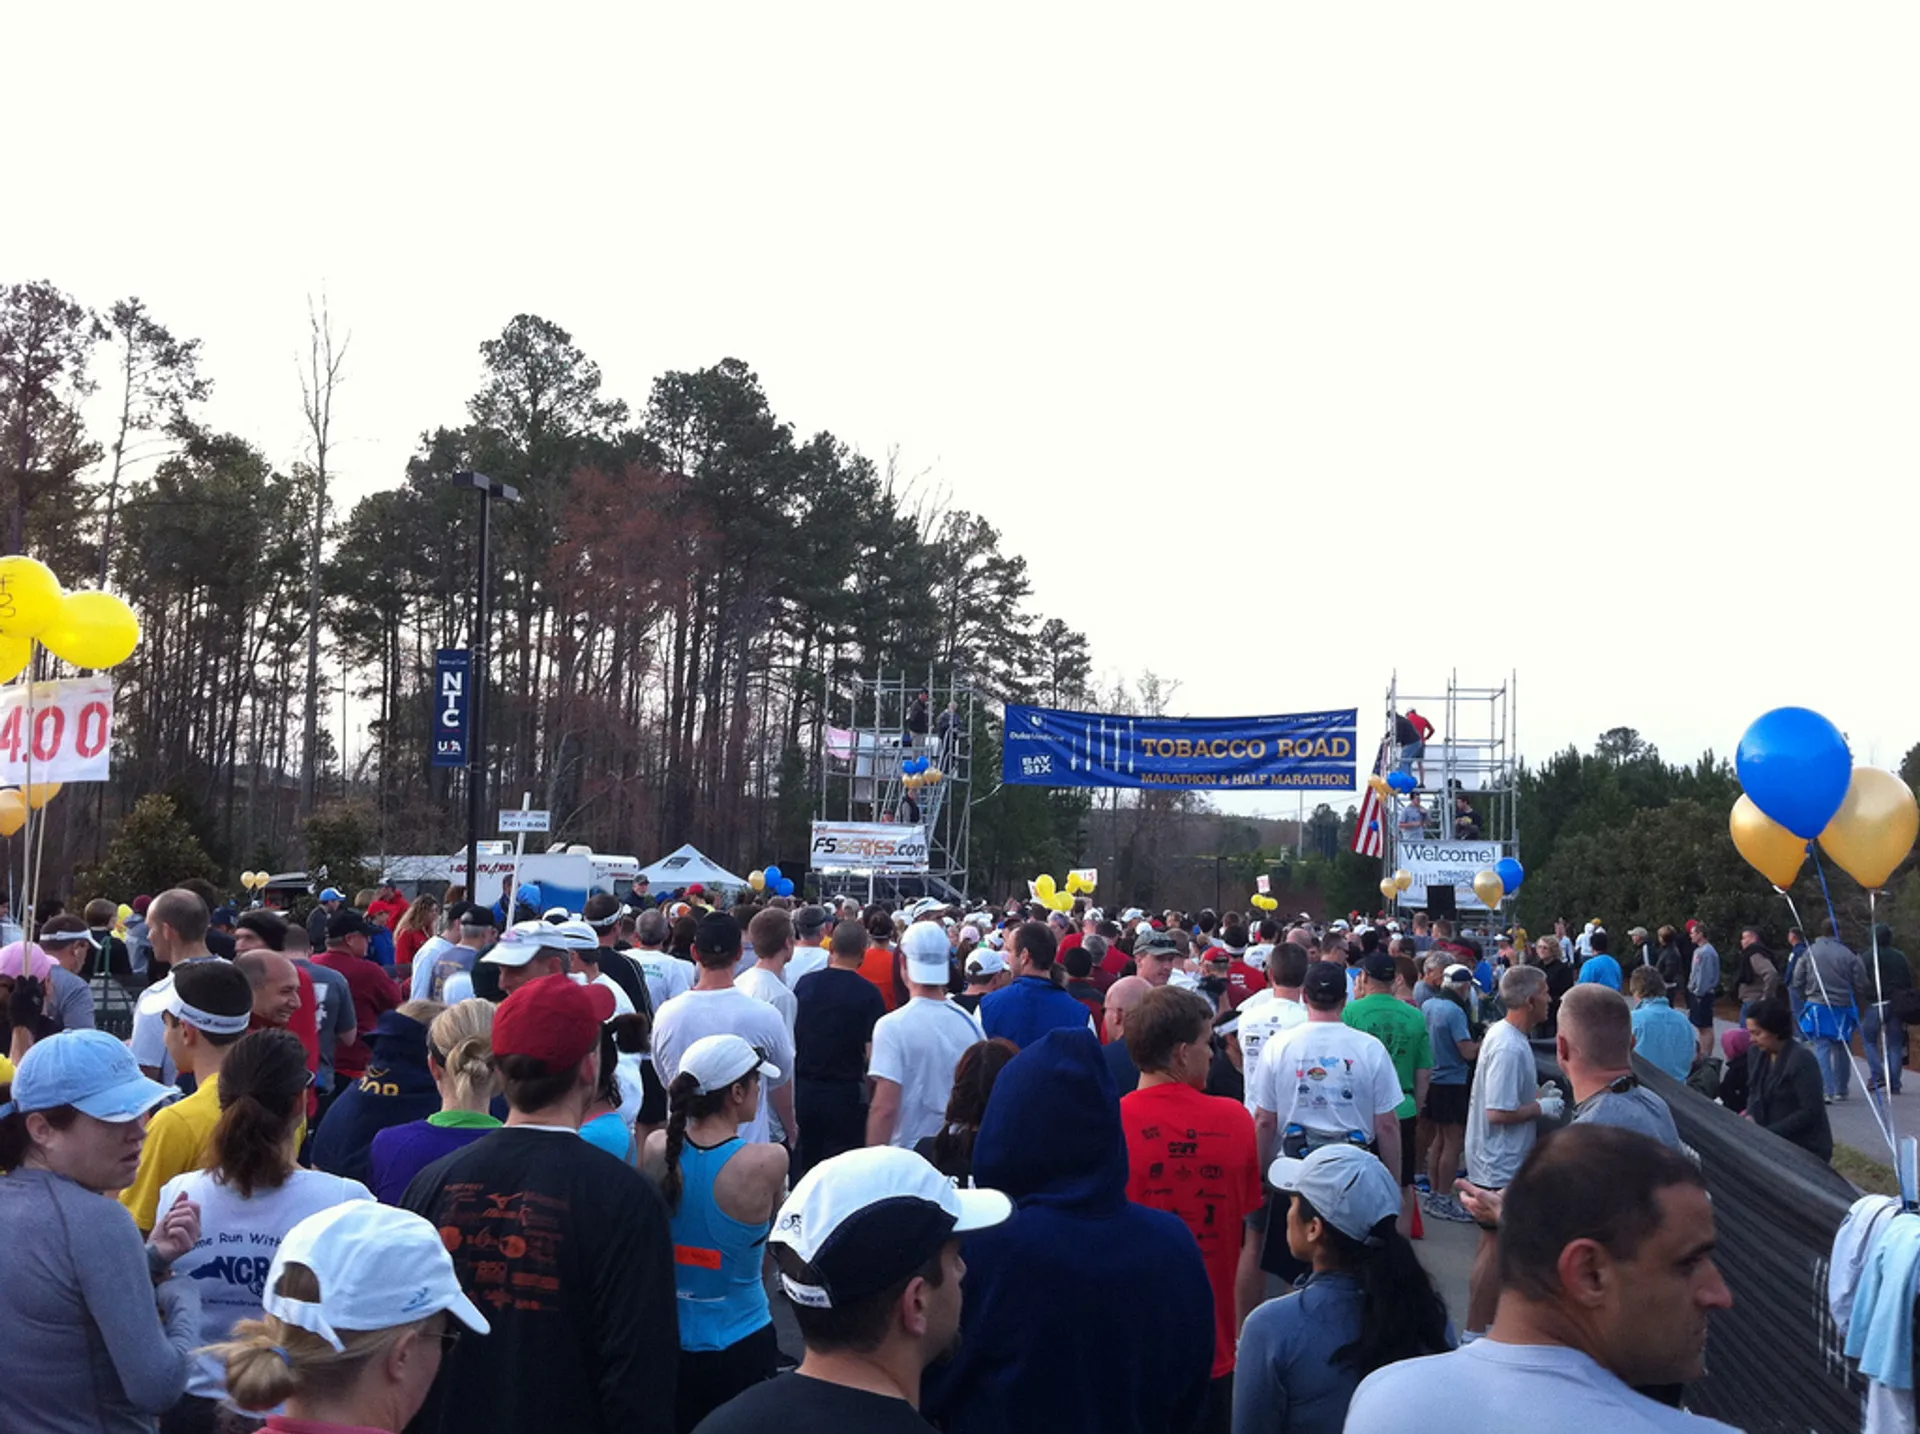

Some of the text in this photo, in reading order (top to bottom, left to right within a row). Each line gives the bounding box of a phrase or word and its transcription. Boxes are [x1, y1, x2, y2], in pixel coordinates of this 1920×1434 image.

[1141, 737, 1351, 758] TOBACCO ROAD
[1141, 772, 1350, 785] MARATHON & HALF MARATHON
[1403, 844, 1496, 863] Welcome!
[220, 1232, 243, 1243] Run
